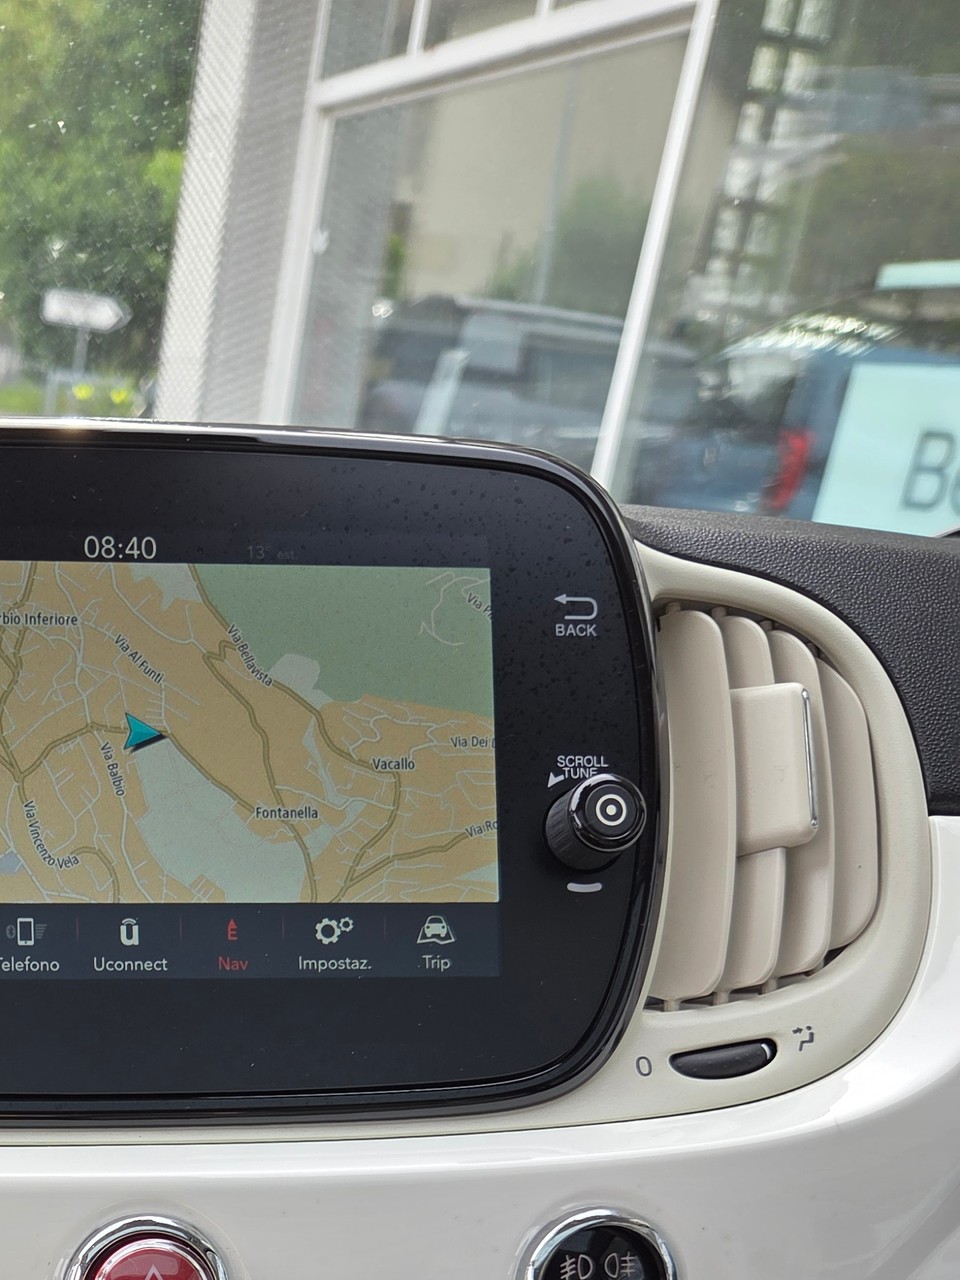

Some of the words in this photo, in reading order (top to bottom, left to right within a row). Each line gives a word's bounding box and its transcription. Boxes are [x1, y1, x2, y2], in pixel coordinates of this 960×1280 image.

[83, 535, 158, 560] 08:40
[467, 592, 483, 610] Via
[24, 612, 78, 627] Inferiore
[555, 623, 597, 637] BACK
[114, 633, 130, 653] Via
[228, 624, 242, 644] Via
[238, 643, 273, 687] Bellavista
[451, 736, 469, 748] Via
[471, 735, 489, 748] Dei
[372, 757, 416, 771] Vacallo
[557, 755, 609, 767] SCROLL
[100, 741, 114, 762] Via
[107, 762, 125, 797] Balbio
[562, 767, 598, 779] TUNE
[24, 800, 36, 819] Via
[255, 806, 319, 819] Fontanella
[464, 825, 483, 838] Via
[28, 820, 56, 867] Vincenzo
[56, 855, 80, 869] Vela
[93, 956, 168, 971] Uconnect
[218, 956, 249, 970] Nav
[298, 956, 372, 975] Impostaz.
[421, 955, 451, 973] Trip
